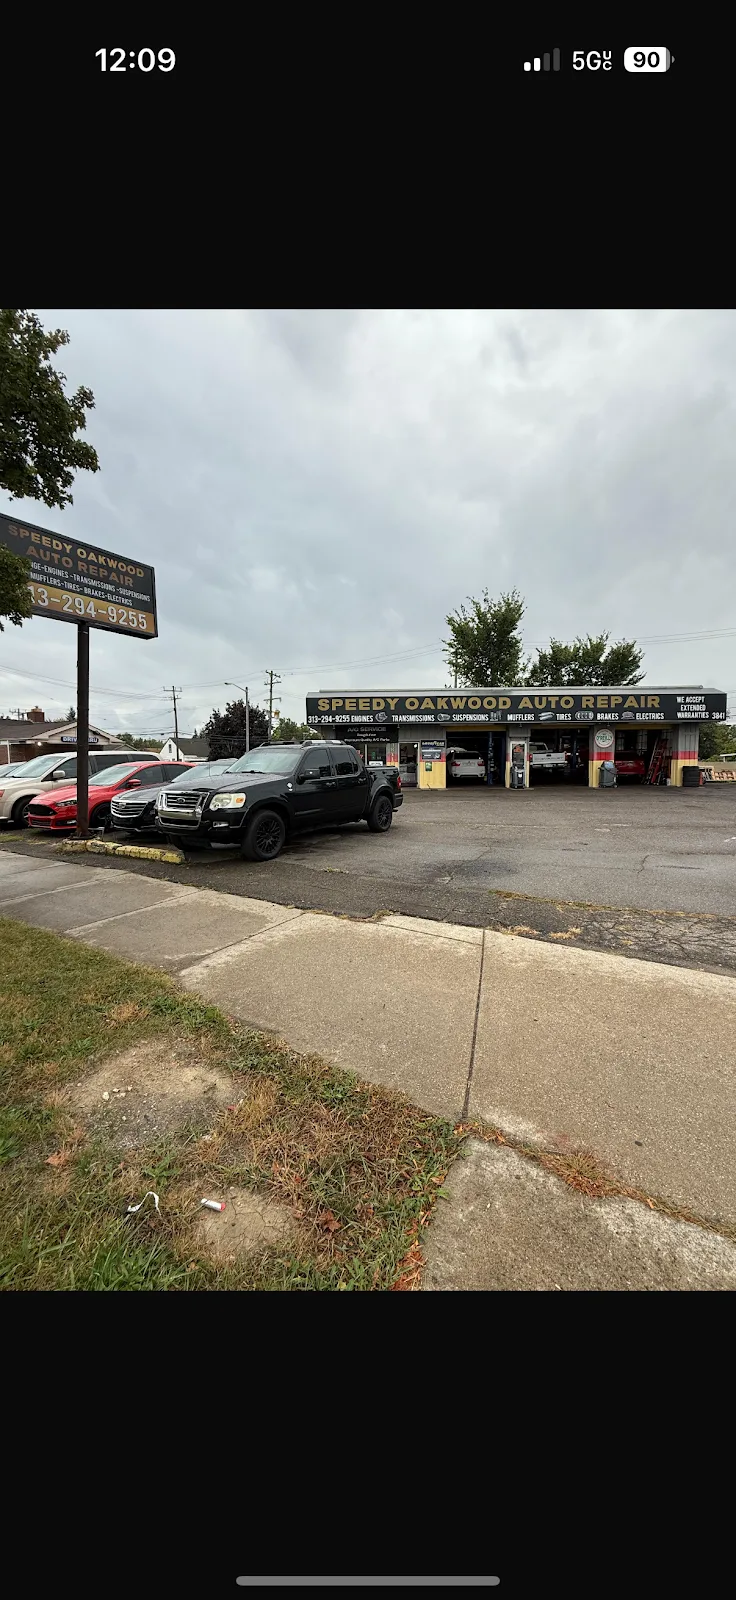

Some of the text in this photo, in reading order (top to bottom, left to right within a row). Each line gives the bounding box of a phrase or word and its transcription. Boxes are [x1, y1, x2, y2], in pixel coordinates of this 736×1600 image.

[8, 524, 145, 577] SPEEDY OAKWOOD
[25, 545, 134, 587] AUTO REPAIR
[27, 585, 148, 630] 13-294-9255
[317, 695, 660, 711] SPEEDY OAKWOOD AUTO REPAIR
[307, 714, 350, 723] 313-294-9255
[391, 714, 435, 722] TRANSMISSIONS
[452, 713, 489, 721] SUSPENSIONS
[507, 713, 535, 721] MUFFLERS
[636, 712, 665, 720] ELECTRICS
[676, 711, 710, 719] WARRANTIES
[711, 712, 725, 720] 3841
